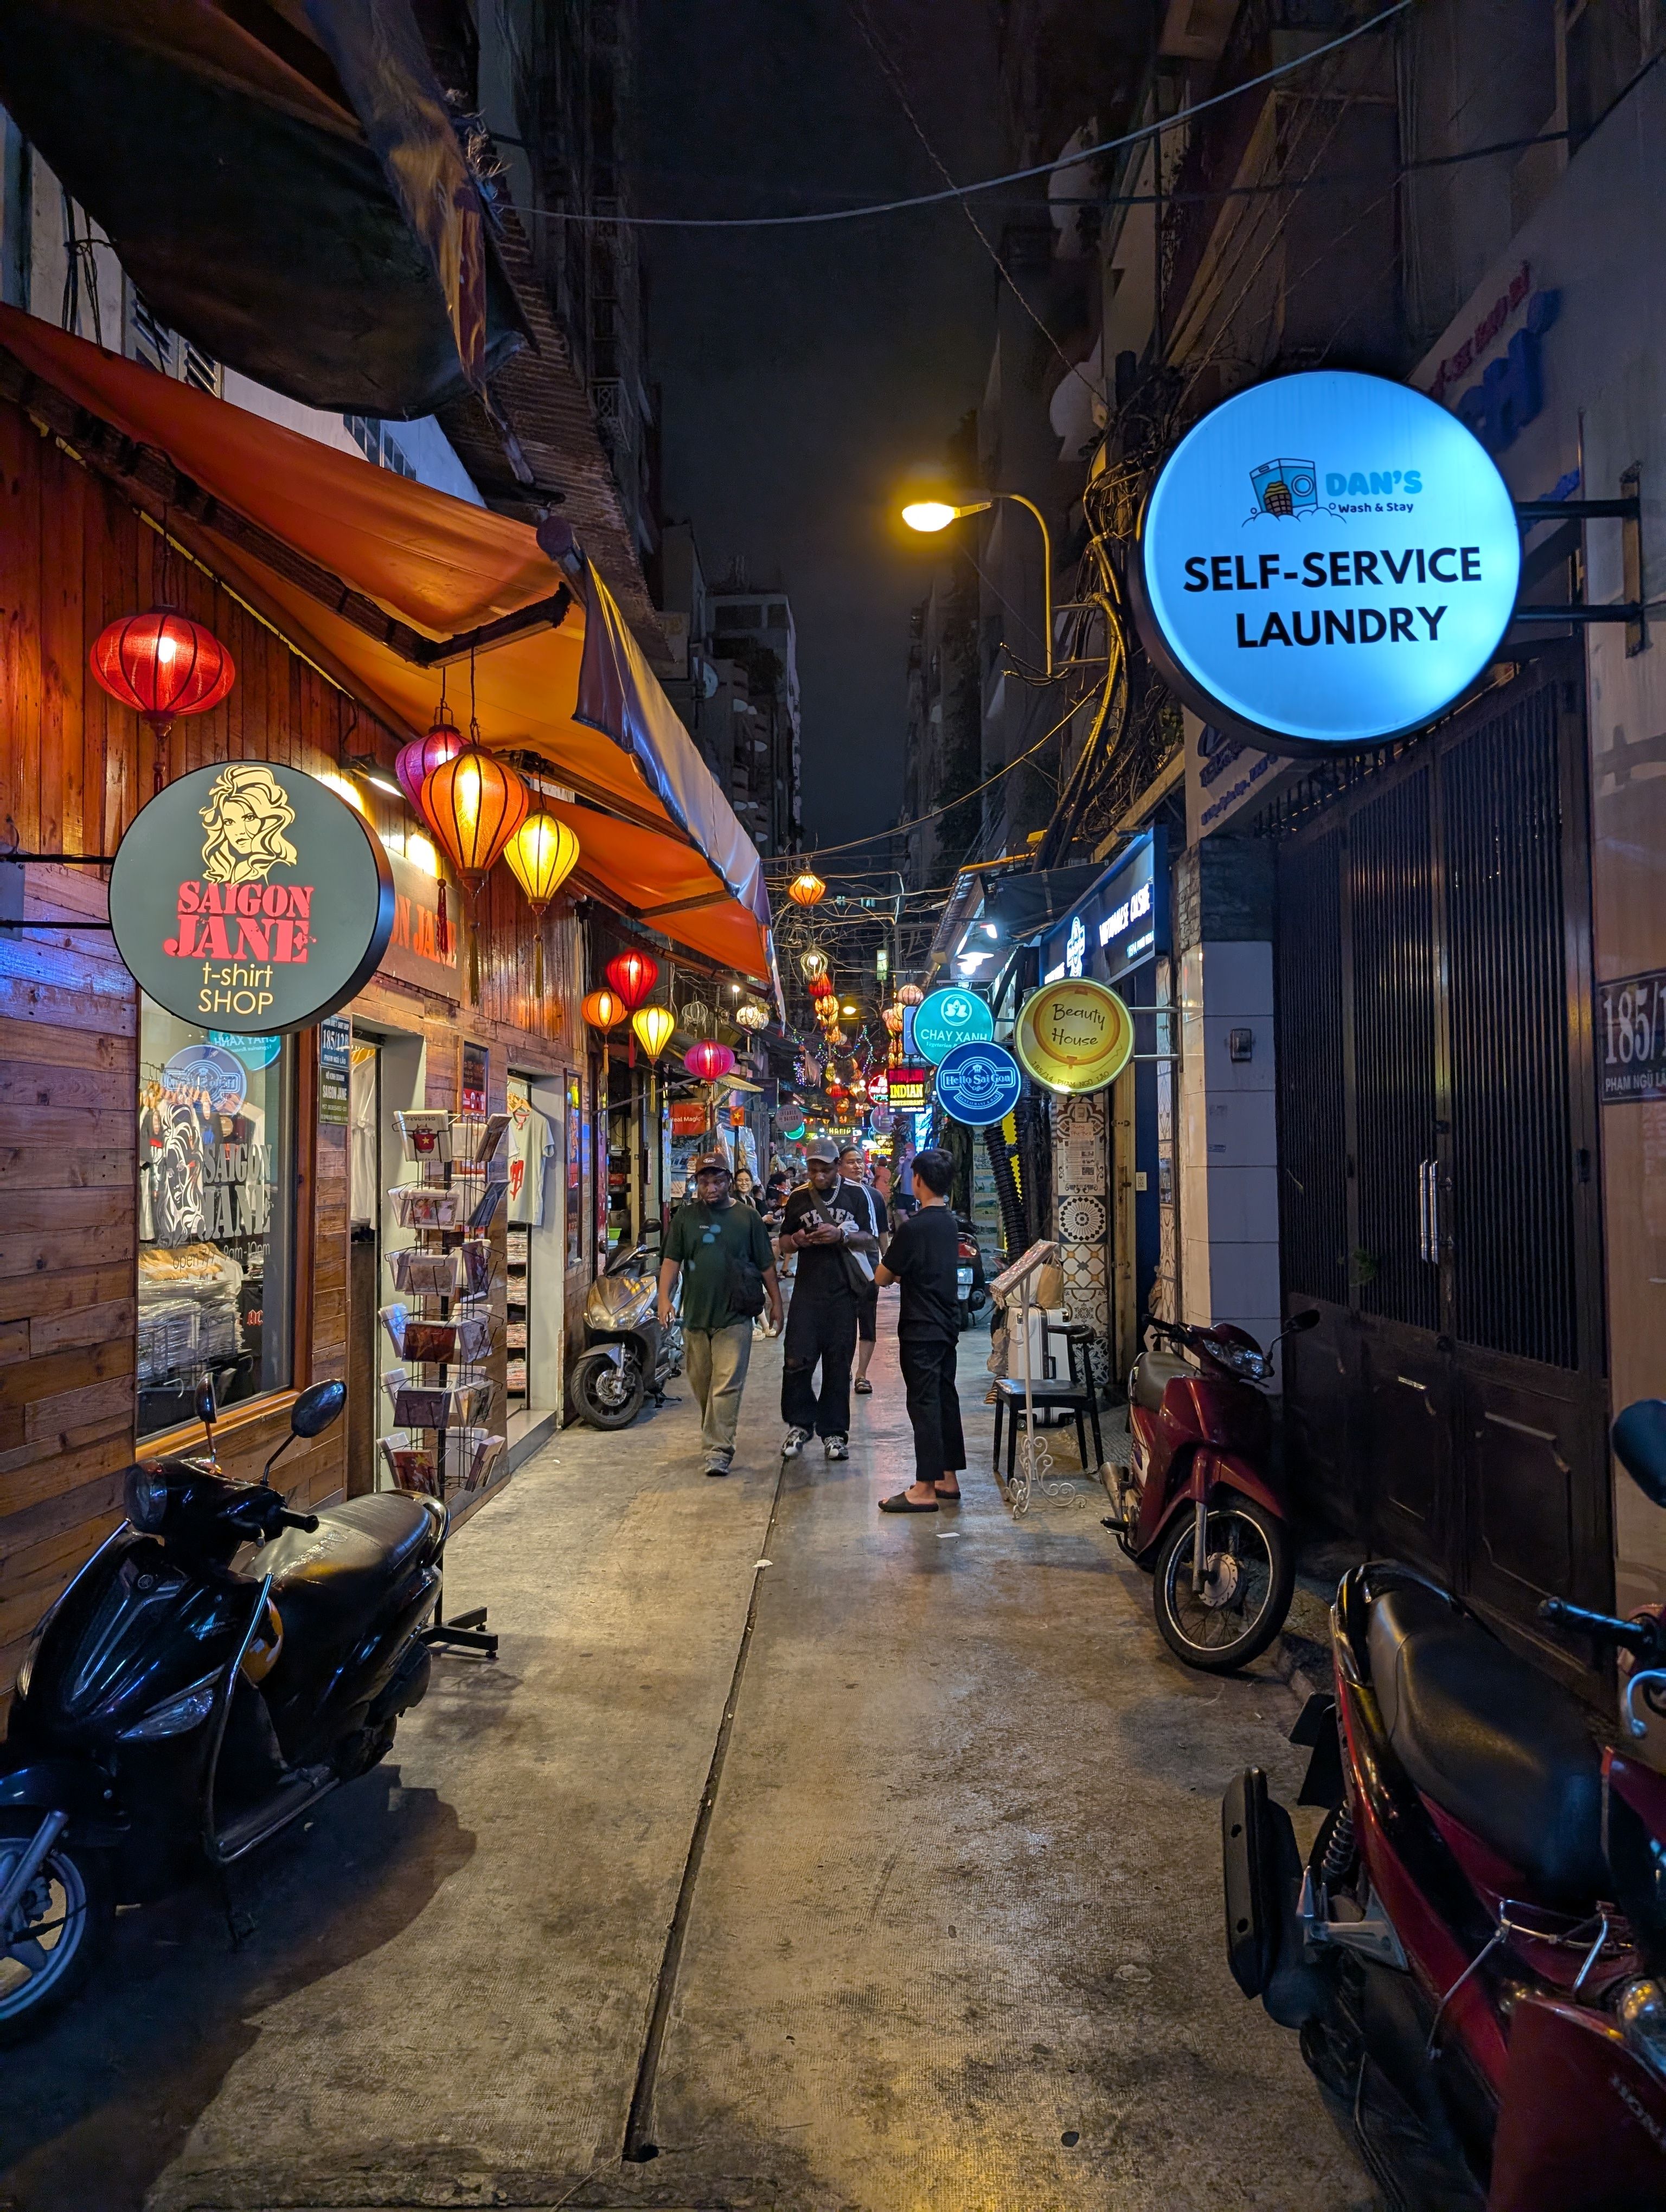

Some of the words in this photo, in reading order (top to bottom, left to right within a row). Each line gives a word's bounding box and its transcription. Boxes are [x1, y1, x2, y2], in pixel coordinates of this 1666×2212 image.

[1325, 470, 1422, 496] DAN'S
[1338, 503, 1372, 513] Wash
[1375, 503, 1383, 513] &
[1386, 501, 1414, 514] Stay
[1183, 546, 1482, 592] SELF-SERVICE
[1236, 606, 1448, 648] LAUNDRY
[177, 881, 315, 918] SAIGON
[163, 914, 310, 963] JANE
[203, 962, 273, 987] t-shirt
[198, 989, 273, 1014] SHOP
[1052, 1004, 1105, 1031] Beauty
[921, 1028, 953, 1041] CHAY
[955, 1032, 987, 1042] XANH
[1052, 1027, 1098, 1046] House
[946, 1075, 972, 1085] Hello
[1031, 1061, 1053, 1082] 185/14
[890, 1084, 923, 1098] INDIAN
[203, 1143, 272, 1184] SAIGON
[197, 1184, 271, 1241] JANE
[174, 1253, 198, 1272] open
